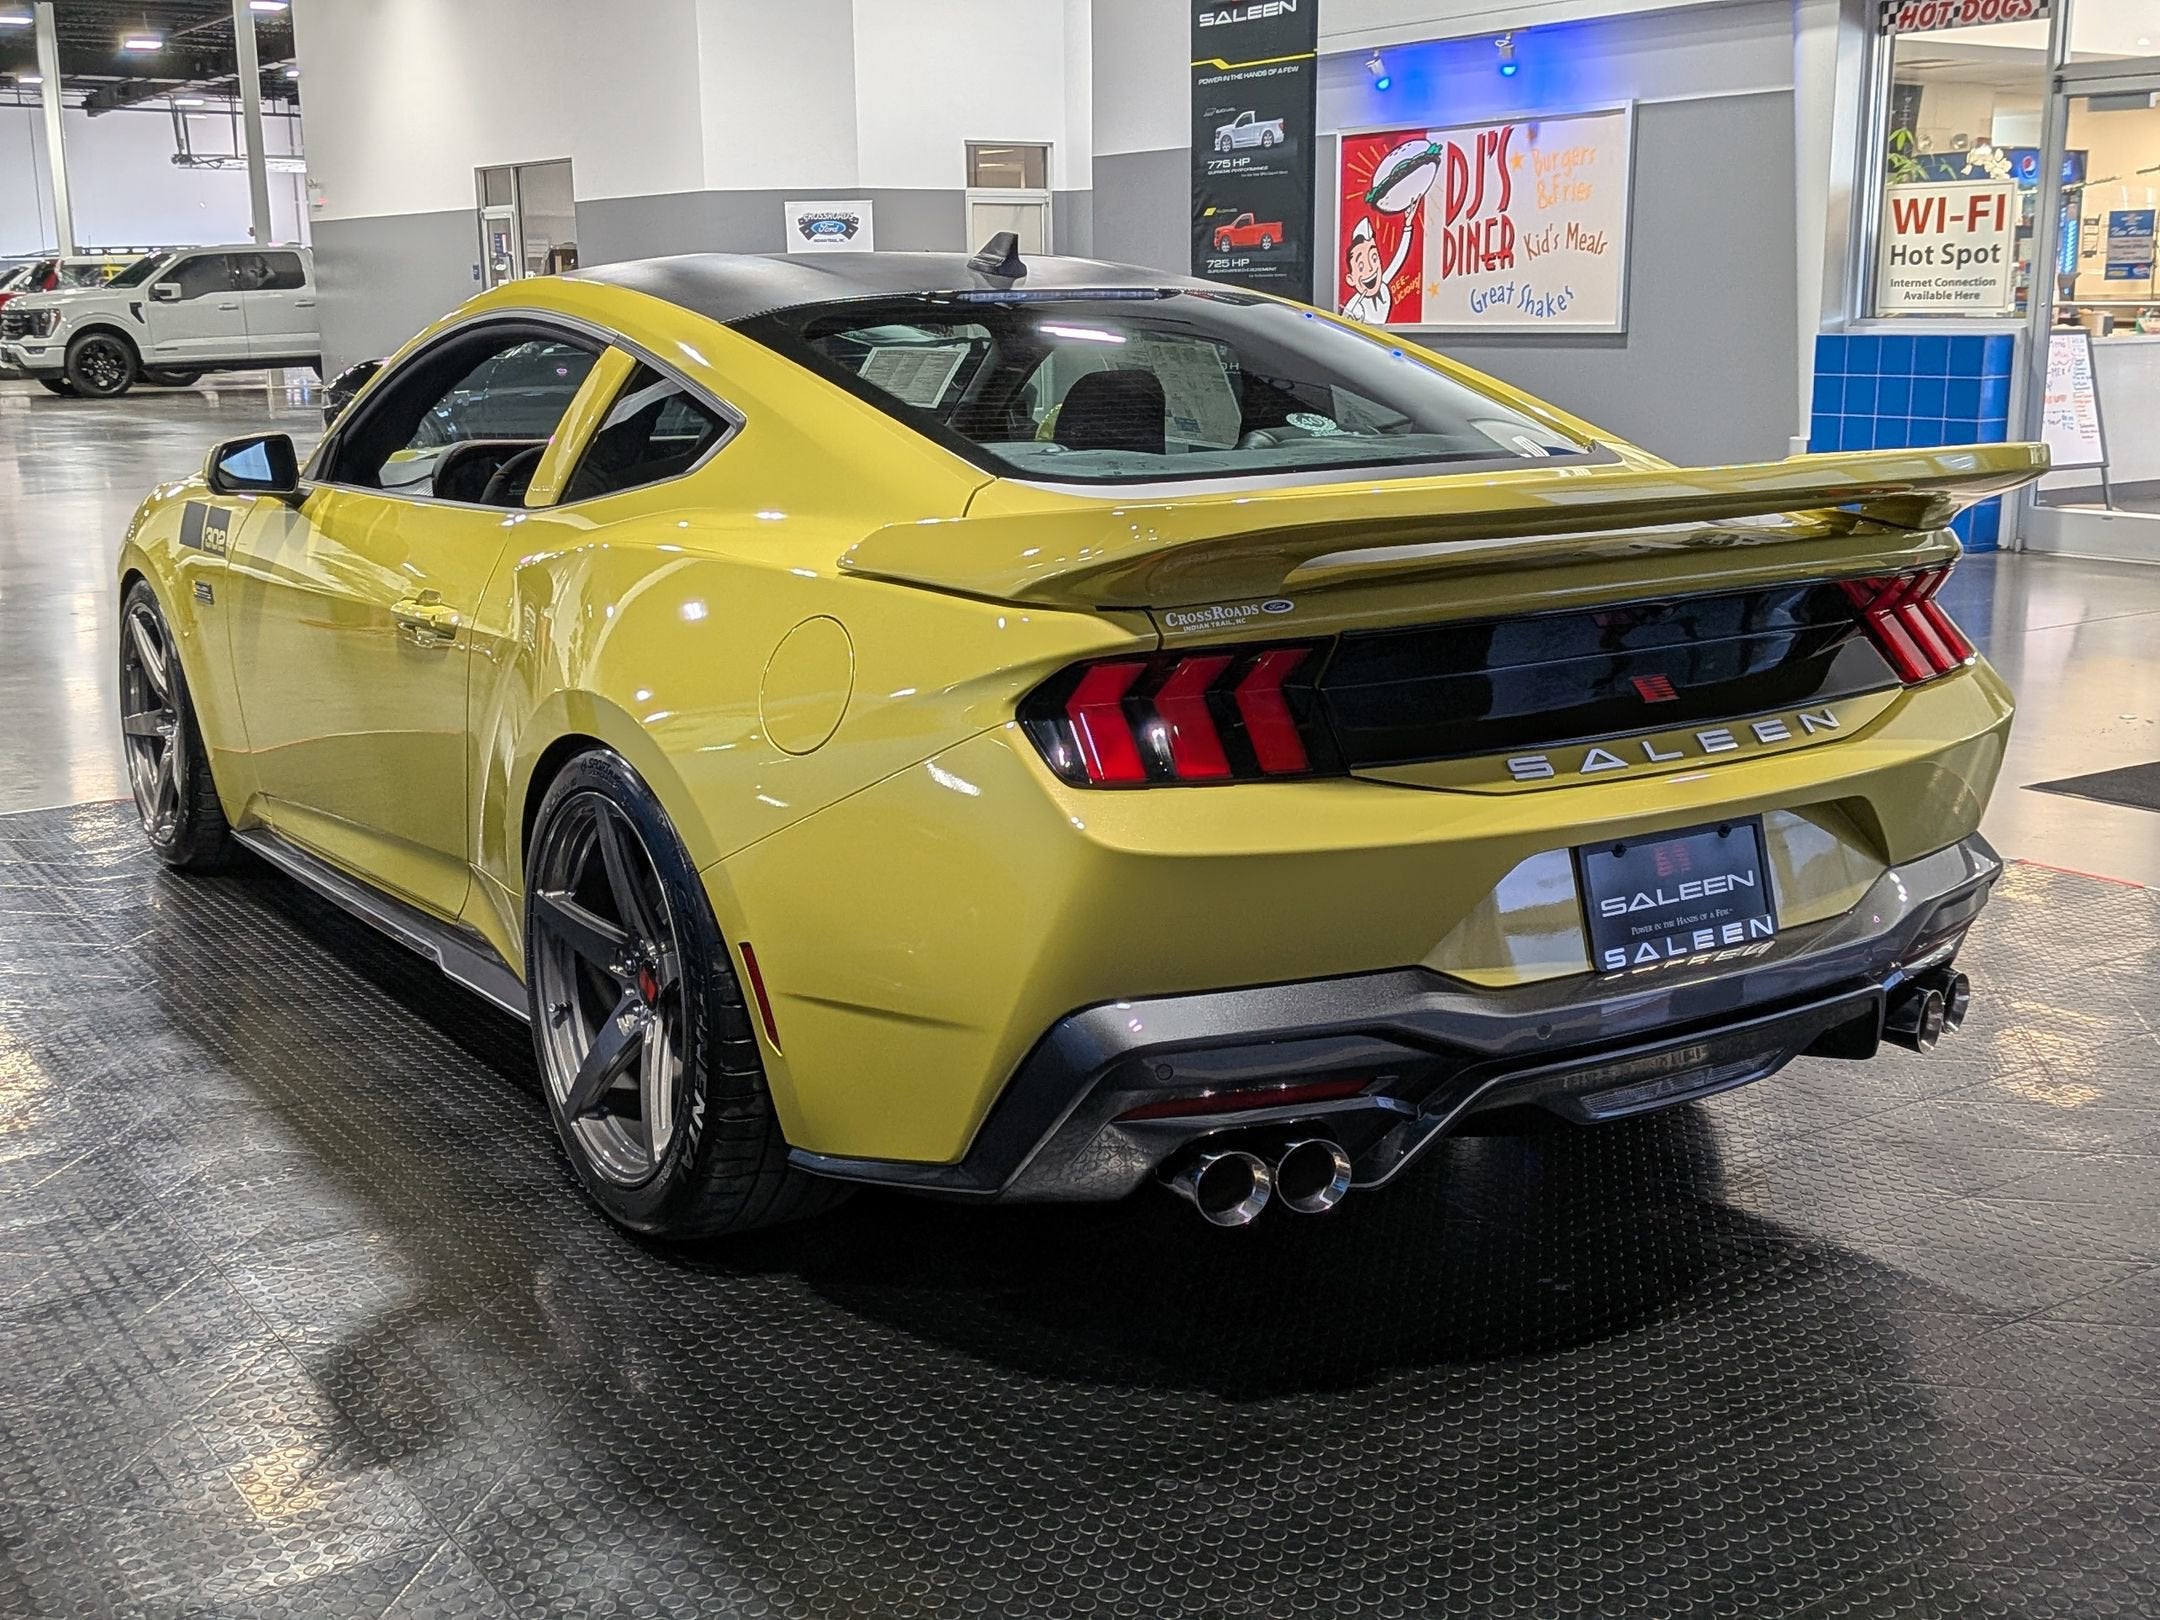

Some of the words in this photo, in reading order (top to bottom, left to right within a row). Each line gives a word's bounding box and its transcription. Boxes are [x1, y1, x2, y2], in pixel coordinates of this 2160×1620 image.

[1199, 0, 1297, 27] SALEEN
[1898, 2, 1953, 29] HOT
[1960, 0, 2032, 22] DOGS
[1243, 70, 1267, 79] HANDS
[1207, 159, 1231, 169] 775
[1232, 157, 1251, 167] HP
[1531, 145, 1596, 177] Burgers
[1445, 125, 1514, 227] DJ'S
[818, 222, 839, 232] Ford
[1892, 193, 2006, 234] WI-FI
[1441, 213, 1515, 280] DINER
[1523, 223, 1560, 261] Kid's
[1565, 221, 1608, 256] Meals
[1206, 259, 1230, 268] 725
[1231, 258, 1250, 267] HP
[1890, 244, 1934, 265] Hot
[1940, 243, 2001, 270] Spot
[1890, 279, 1932, 288] Internet
[1934, 276, 1996, 287] Connection
[1904, 290, 1952, 300] Available
[1954, 290, 1981, 300] Here
[1470, 280, 1515, 314] Great
[1516, 284, 1574, 318] Shakes
[205, 526, 226, 553] 302
[1183, 622, 1210, 632] INDIAN
[1212, 618, 1236, 628] TRAIL,
[1507, 708, 1840, 780] SALEEN
[1601, 869, 1755, 918] SALEEN
[1604, 915, 1774, 970] SALEEN
